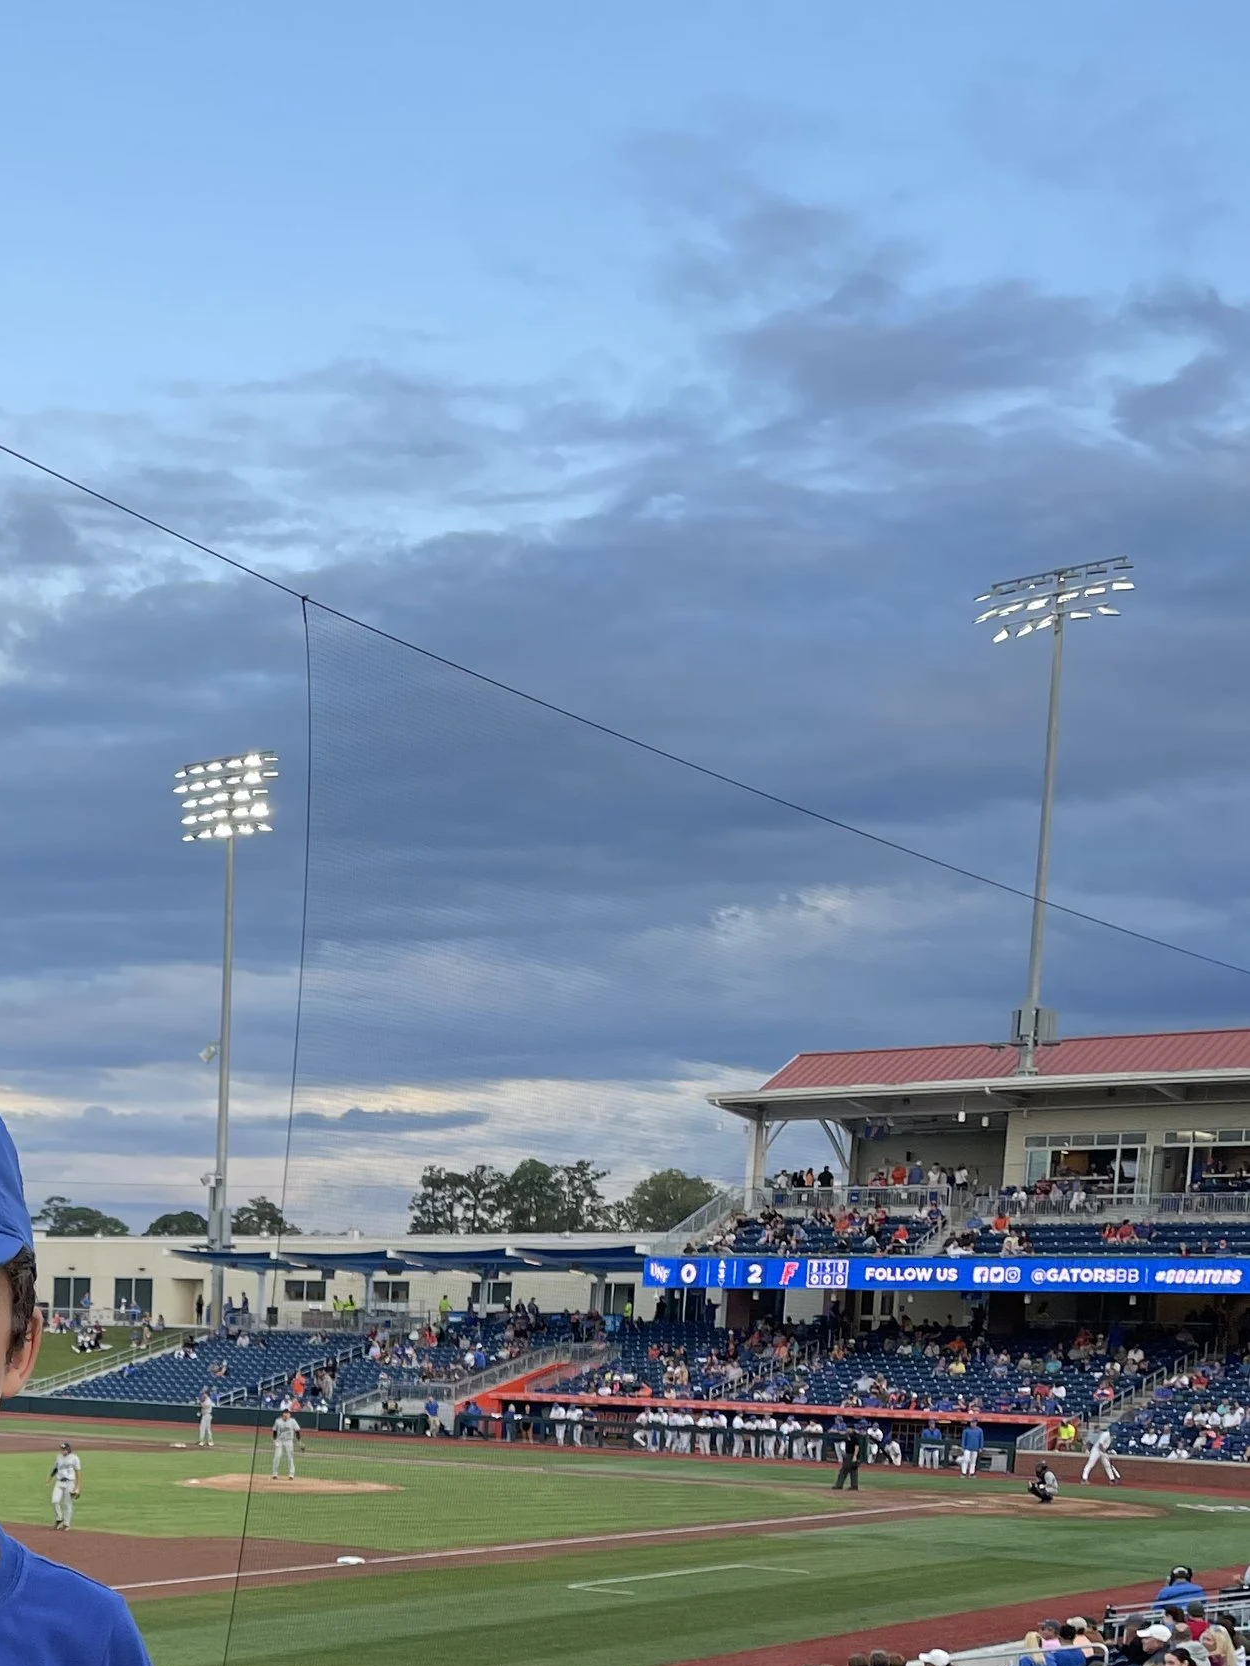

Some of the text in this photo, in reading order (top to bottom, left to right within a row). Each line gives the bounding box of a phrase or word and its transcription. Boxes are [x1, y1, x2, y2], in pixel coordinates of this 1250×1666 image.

[650, 1261, 697, 1284] UNF 0
[747, 1264, 762, 1284] 2
[865, 1267, 958, 1282] FOLLOW US
[1031, 1267, 1140, 1285] @GATORSBB
[1155, 1269, 1243, 1285] #GOGATORS
